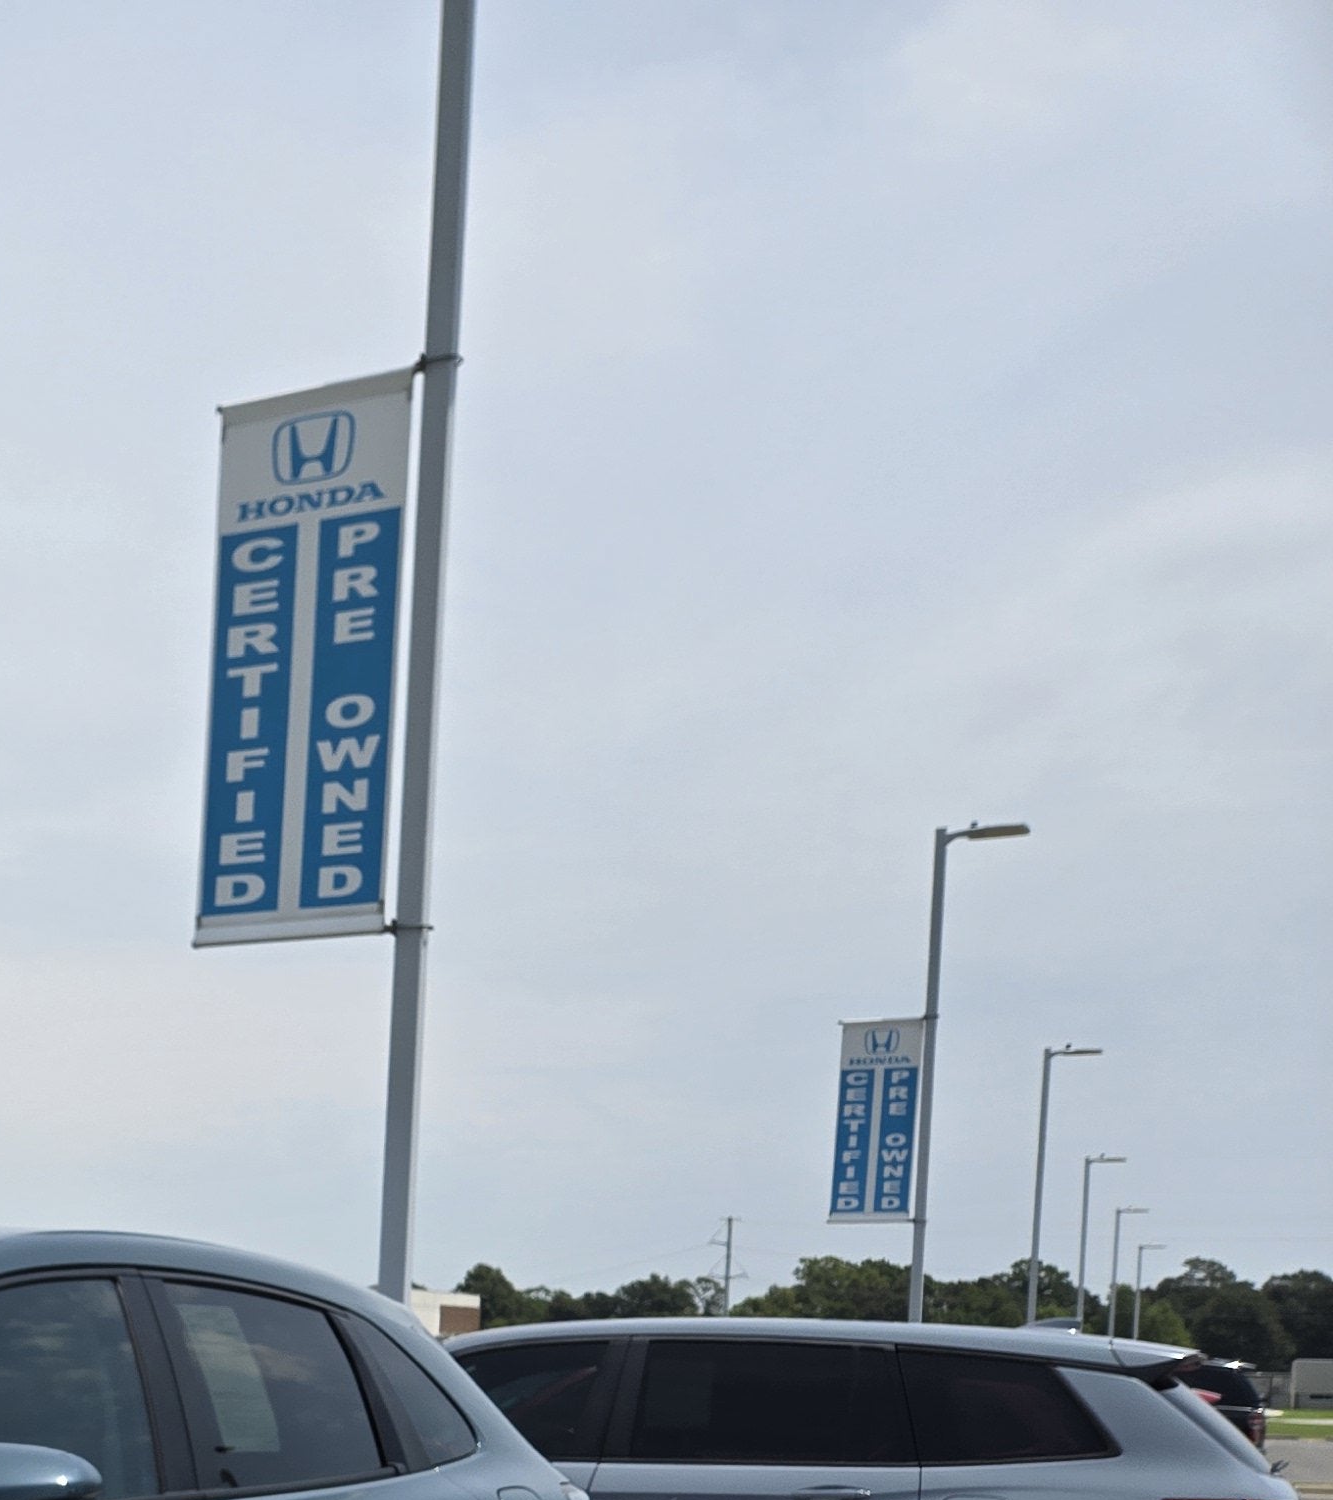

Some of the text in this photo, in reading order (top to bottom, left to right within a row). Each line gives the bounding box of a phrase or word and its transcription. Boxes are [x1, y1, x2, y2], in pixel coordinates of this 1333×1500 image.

[236, 480, 386, 523] HONDA
[213, 536, 285, 907] CERTIFIED
[316, 521, 381, 900] PRE OWNED
[836, 1071, 869, 1210] CERTIFIED
[881, 1070, 910, 1210] PRE OWNED
